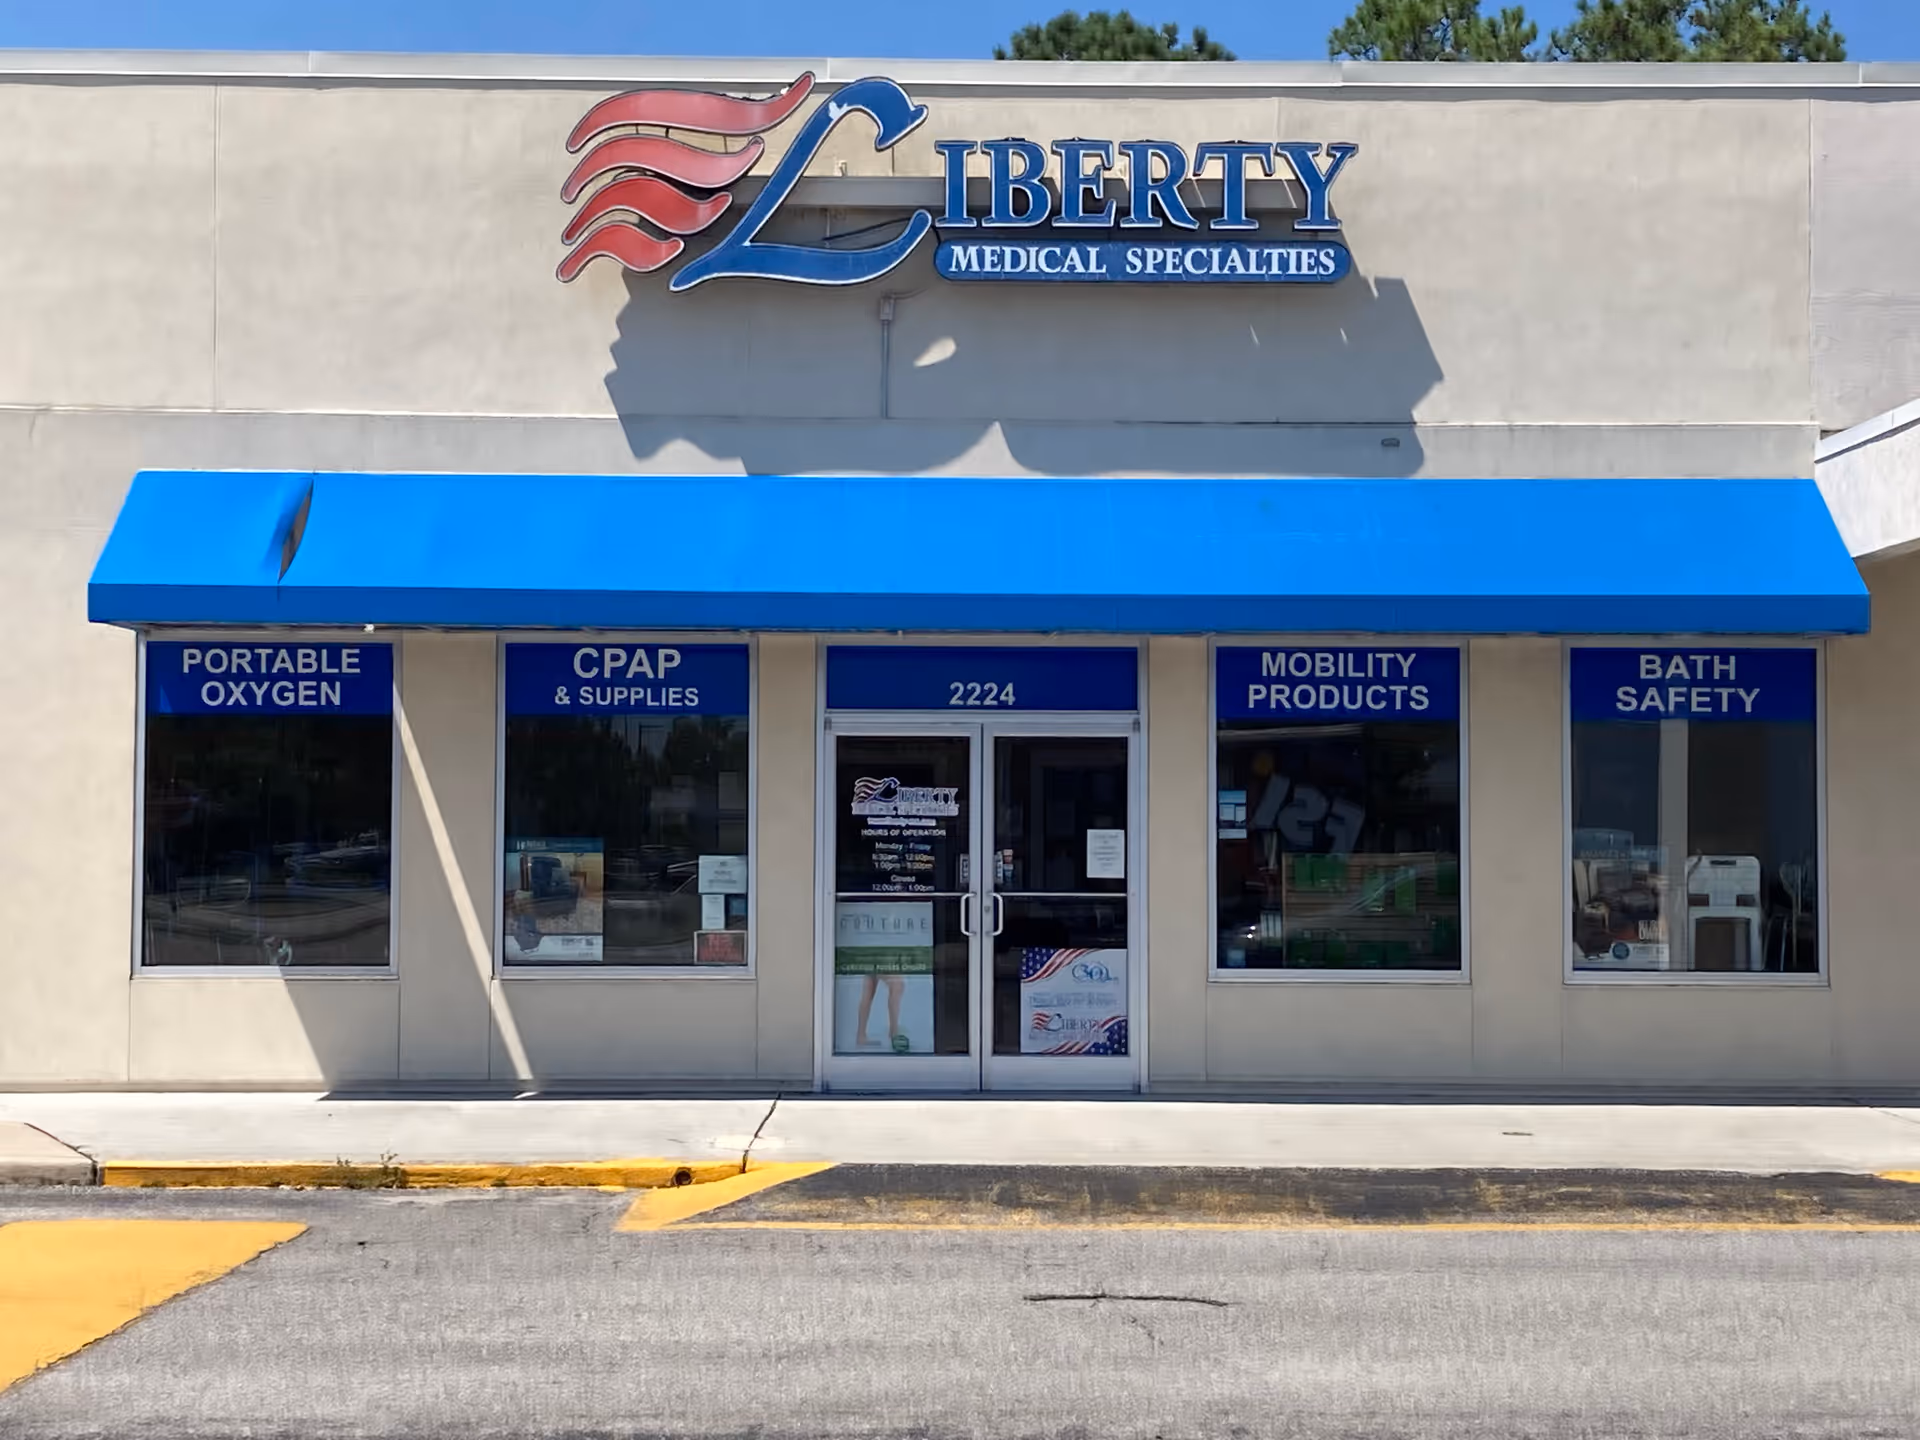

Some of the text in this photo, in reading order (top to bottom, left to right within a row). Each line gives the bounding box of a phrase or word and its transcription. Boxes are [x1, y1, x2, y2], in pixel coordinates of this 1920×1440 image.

[670, 76, 1360, 292] LIBERTY
[949, 245, 1336, 275] MEDICAL SPECIALTIES
[182, 647, 362, 674] PORTABLE
[572, 647, 682, 679] CPAP
[1261, 651, 1417, 678] MOBILITY
[1639, 654, 1737, 681] BATH
[200, 680, 342, 707] OXYGEN
[554, 686, 700, 707] & SUPPLIES
[949, 681, 1017, 706] 2224
[1247, 684, 1430, 711] PRODUCTS
[1615, 686, 1760, 713] SAFETY
